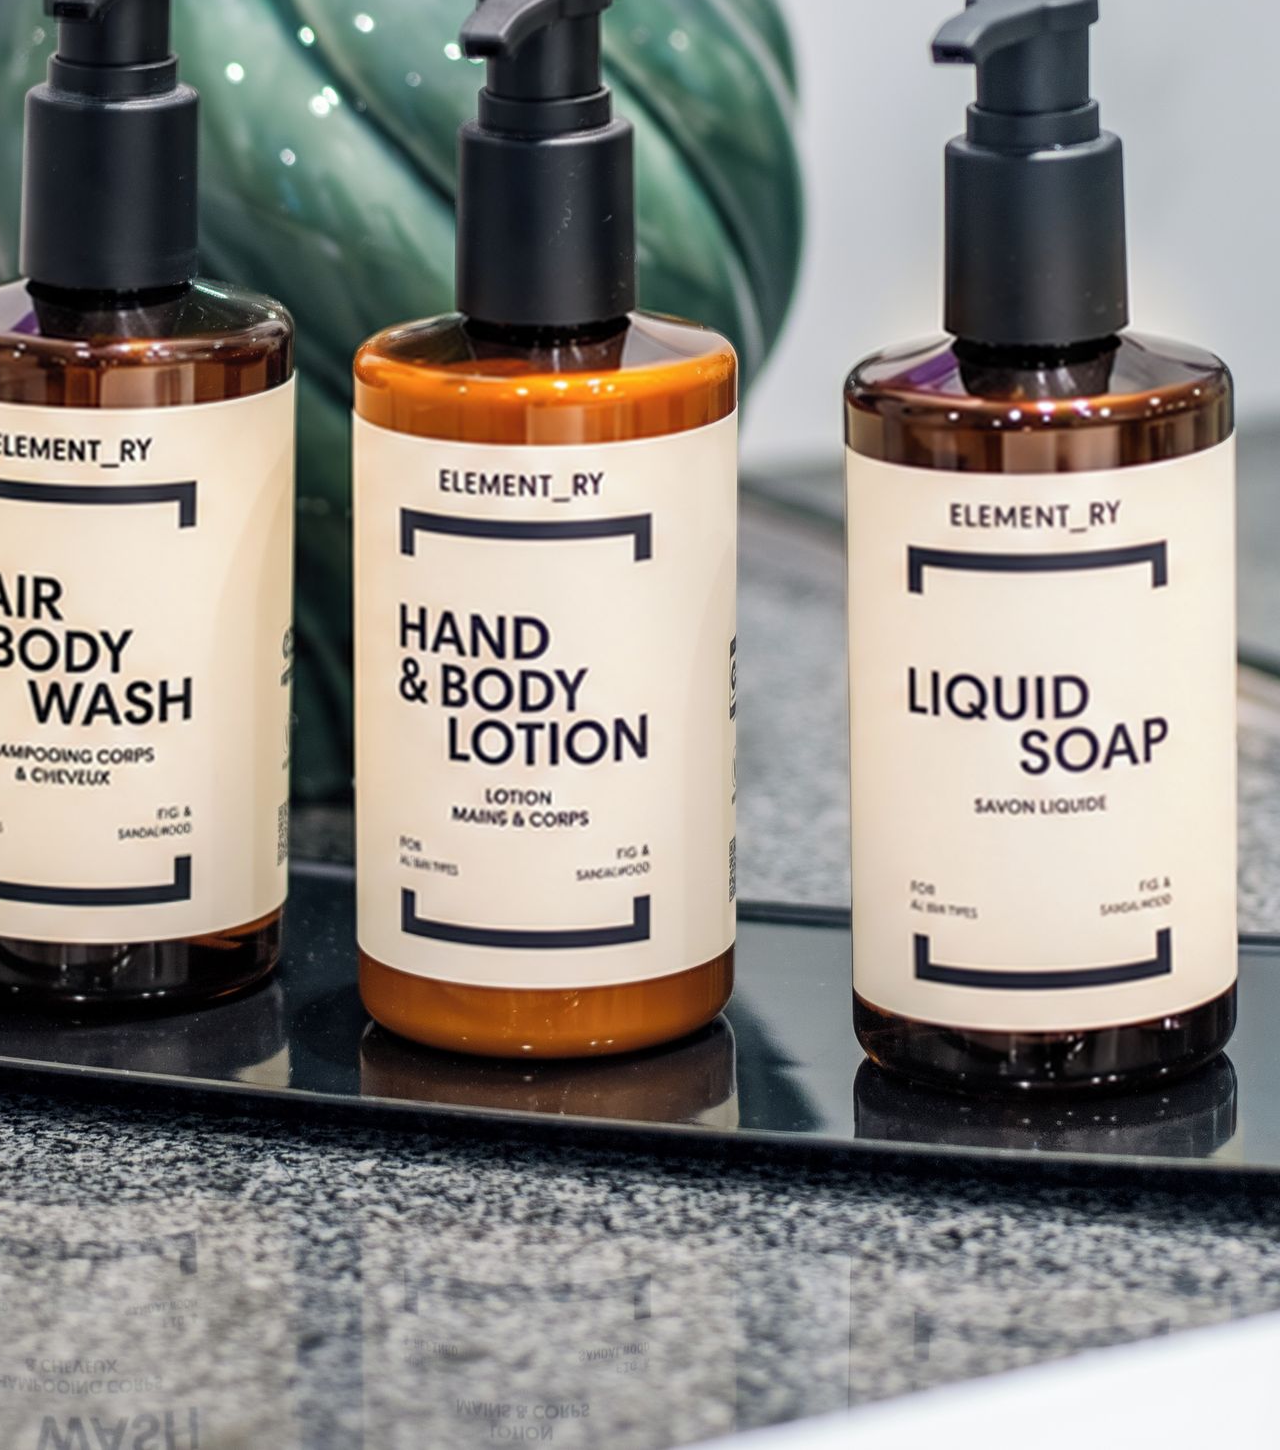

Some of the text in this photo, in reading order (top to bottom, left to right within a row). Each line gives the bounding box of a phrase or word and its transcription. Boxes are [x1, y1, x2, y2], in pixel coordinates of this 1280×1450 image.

[439, 468, 604, 503] ELEMENT_RY
[949, 501, 1120, 533] ELEMENT_RY
[400, 603, 550, 660] HAND
[399, 656, 588, 713] & BODY
[908, 666, 1089, 721] LIQUID
[27, 677, 192, 727] WASH
[96, 746, 155, 765] CORPS
[448, 714, 648, 767] LOTION
[1020, 717, 1168, 776] SOAP
[15, 766, 111, 786] & CHEVEUX
[485, 788, 552, 807] LOTION
[974, 795, 1106, 815] SAVON LIQUIDE
[117, 821, 192, 840] SANDALWOOD
[452, 806, 590, 828] MAINS & CORPS
